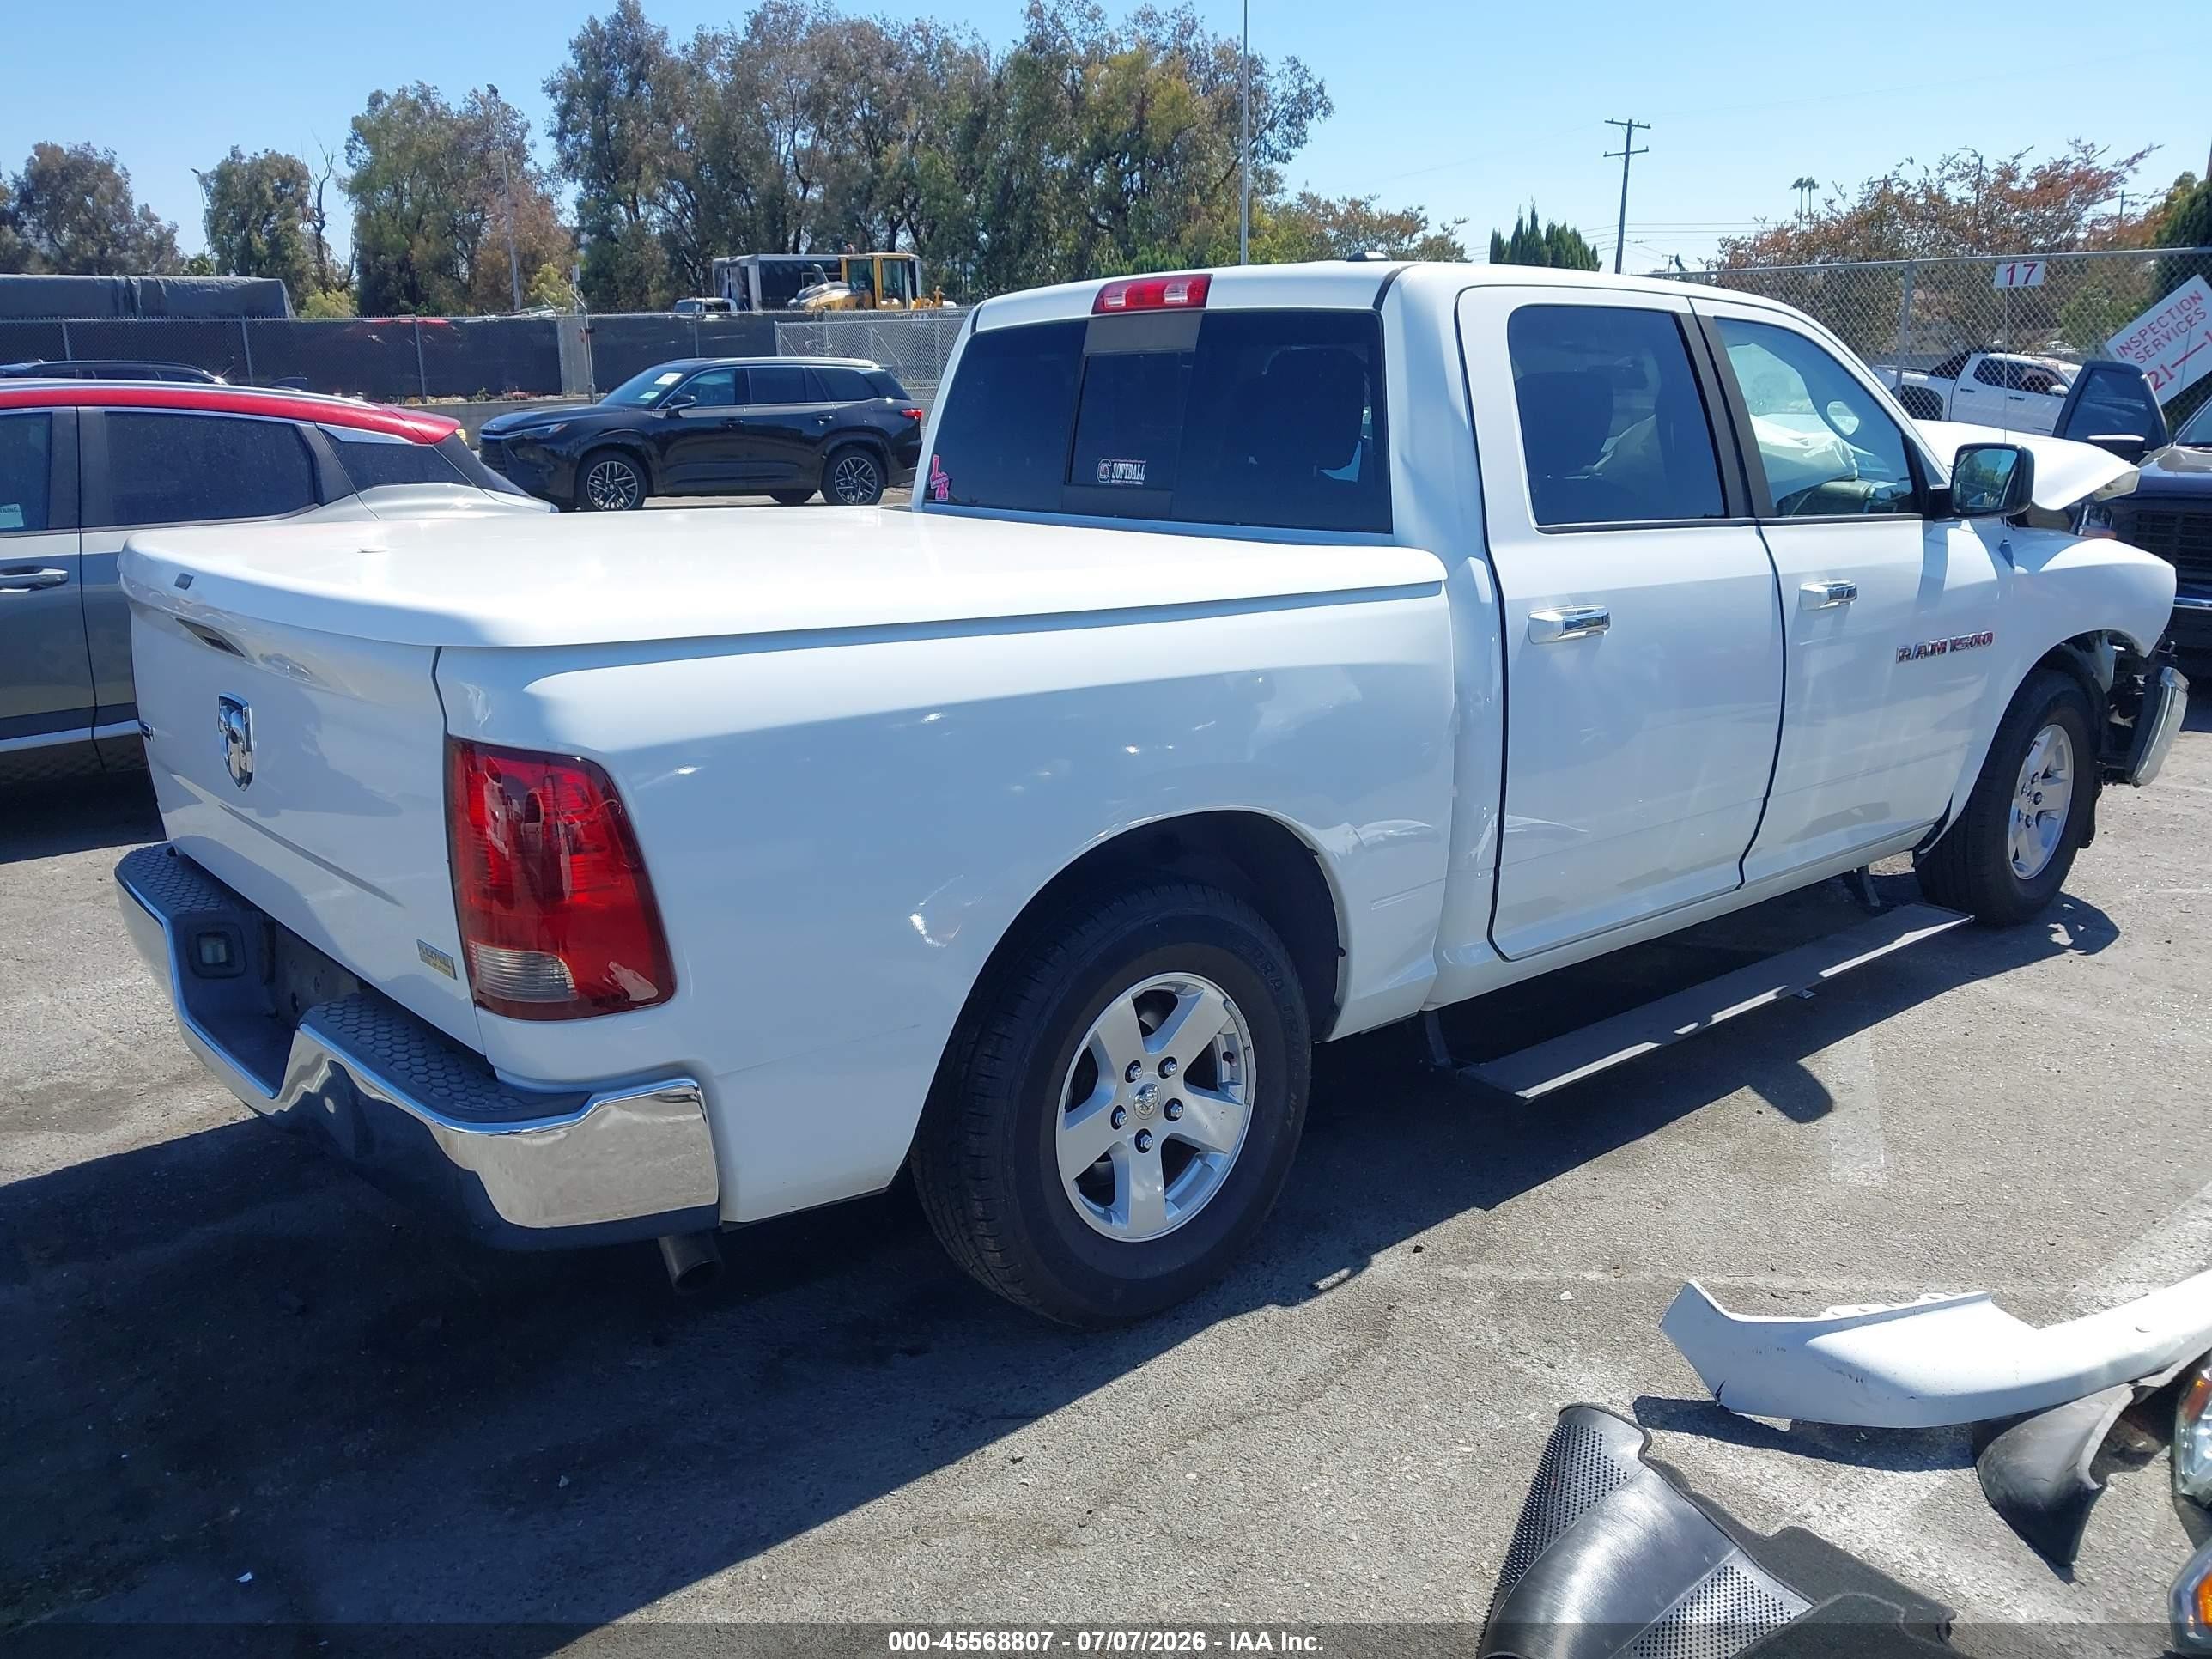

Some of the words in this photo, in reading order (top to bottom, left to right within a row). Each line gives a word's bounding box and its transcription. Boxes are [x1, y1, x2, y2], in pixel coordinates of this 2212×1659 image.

[2007, 263, 2039, 286] 17
[2115, 290, 2203, 358] INSPECTION
[2134, 307, 2207, 363] SERVICES
[1111, 462, 1146, 481] SOFTBALL
[1896, 639, 1948, 664] RAM
[1949, 631, 1994, 653] 1500
